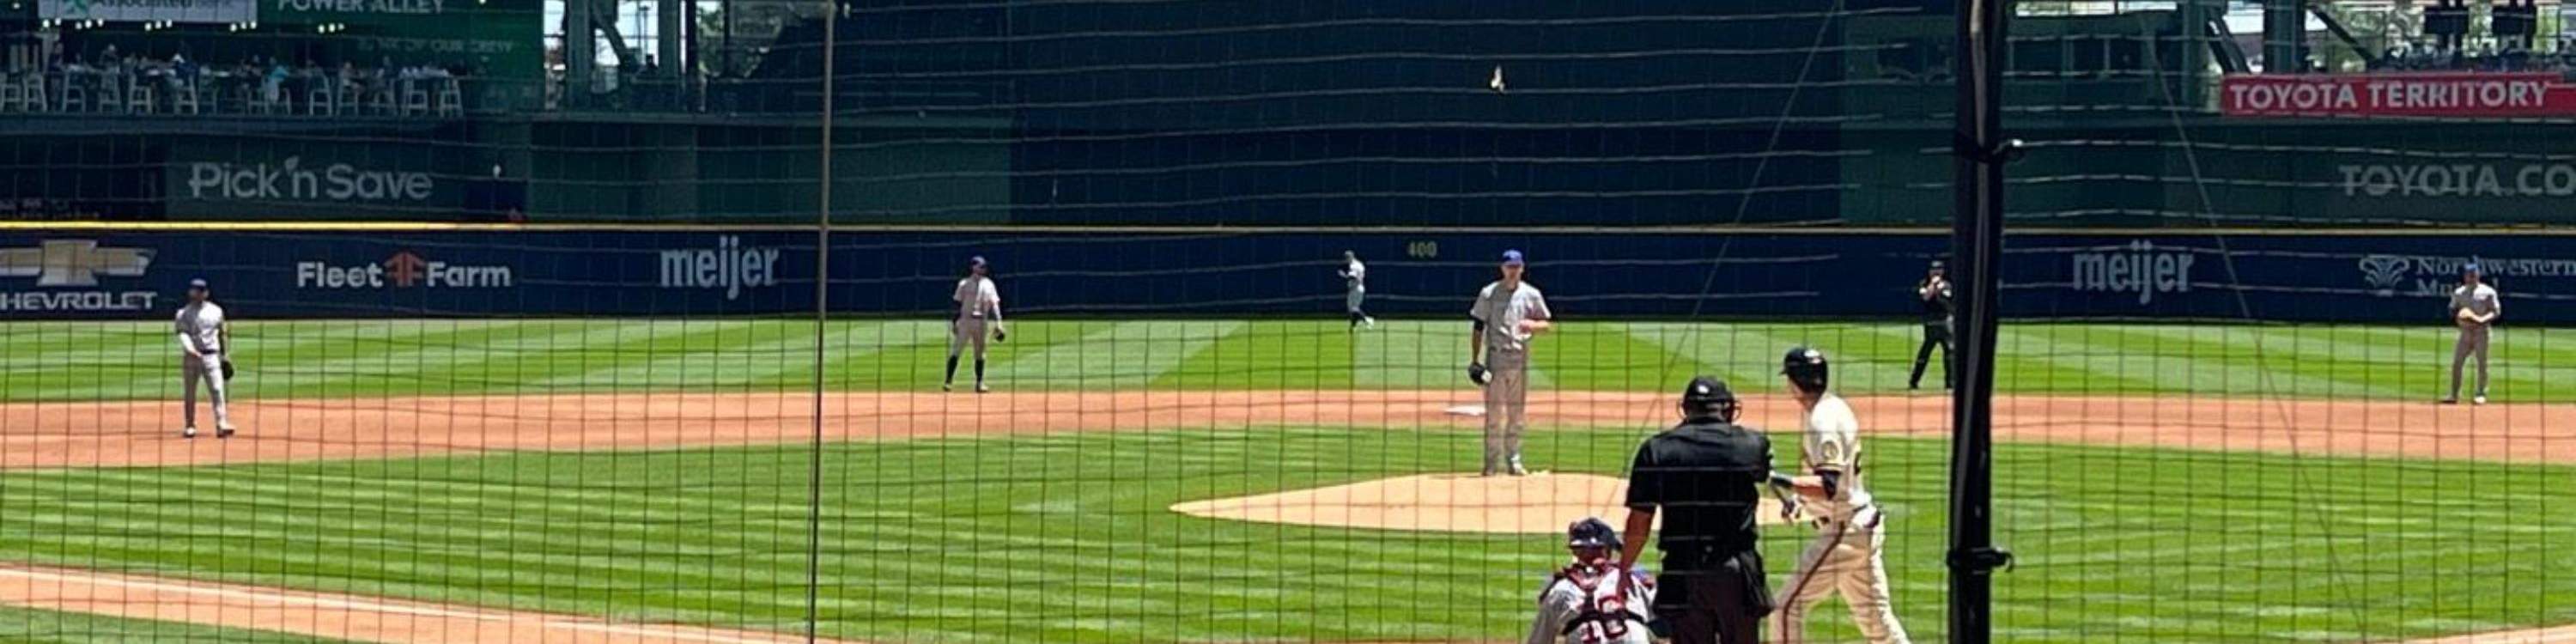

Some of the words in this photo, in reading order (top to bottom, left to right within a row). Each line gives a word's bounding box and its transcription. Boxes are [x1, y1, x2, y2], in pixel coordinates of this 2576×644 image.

[2230, 82, 2358, 109] TOYOTA
[2367, 80, 2552, 108] TERRITORY
[325, 163, 433, 199] Save
[1406, 240, 1437, 258] 400
[297, 262, 383, 288] Fleet
[427, 262, 512, 288] Farm
[660, 235, 779, 300] meijer
[2073, 240, 2194, 304] meijer
